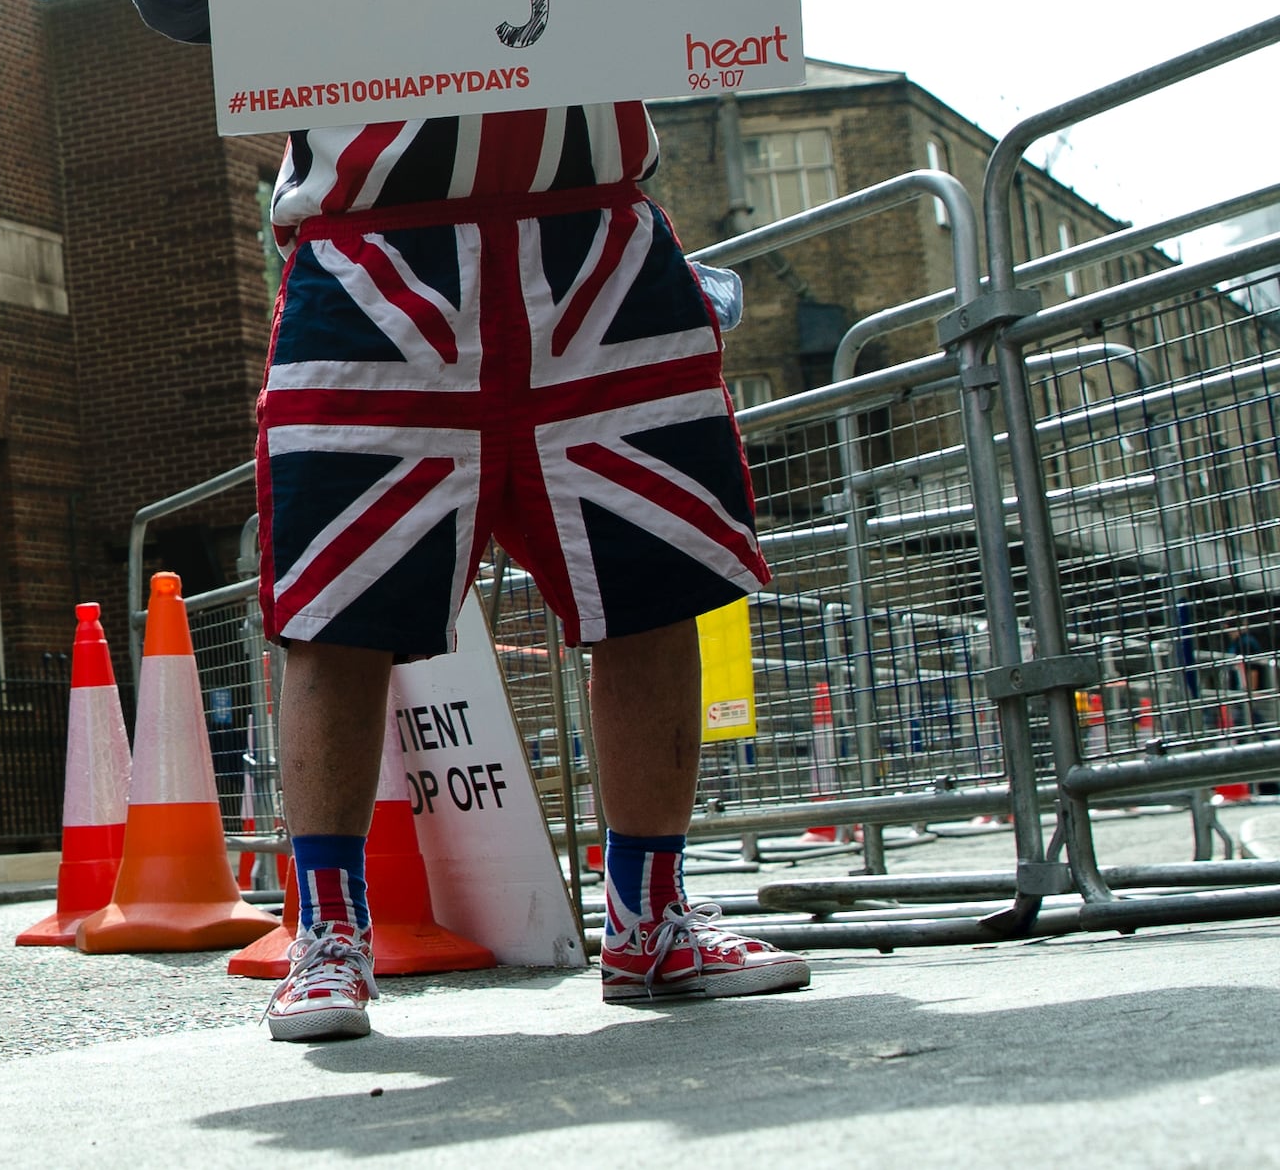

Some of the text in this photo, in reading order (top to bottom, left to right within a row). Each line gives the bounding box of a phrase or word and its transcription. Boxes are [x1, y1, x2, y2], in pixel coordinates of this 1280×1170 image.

[686, 25, 789, 70] heart
[228, 66, 530, 114] #HEARTS100HAPPYDAYS
[688, 69, 744, 90] 96-107
[396, 700, 473, 753] TIENT
[446, 762, 507, 812] OFF
